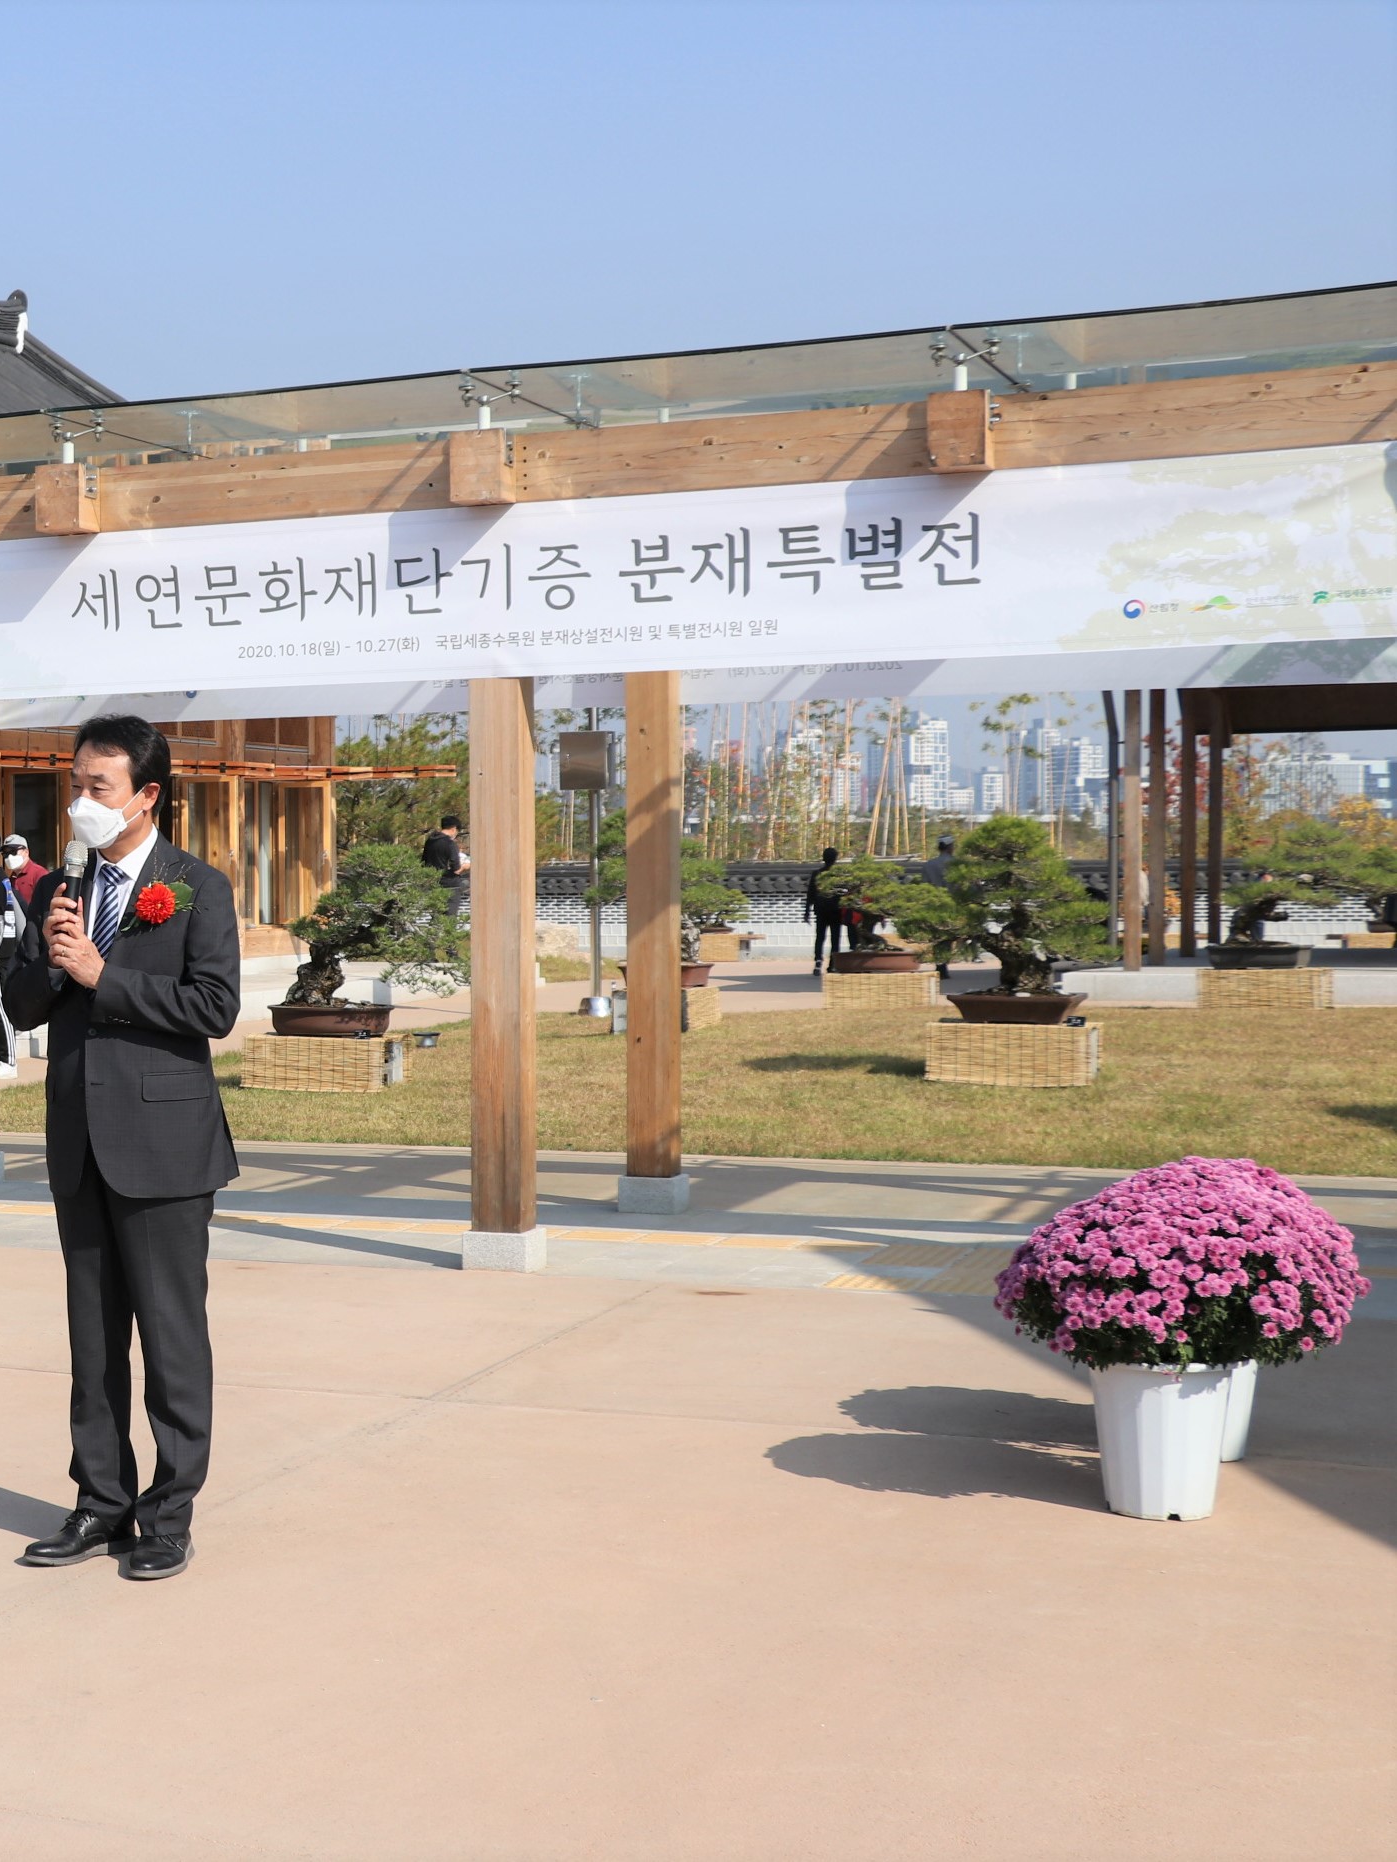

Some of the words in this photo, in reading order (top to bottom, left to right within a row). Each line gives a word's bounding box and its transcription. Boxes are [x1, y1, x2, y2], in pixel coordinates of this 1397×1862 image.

[71, 542, 592, 632] 세연문화재단기증
[618, 511, 982, 603] 분재특별전
[238, 641, 341, 658] 2020.10.18(일)
[356, 636, 421, 653] 10.27(화)
[435, 631, 535, 649] 국립세종수목원
[540, 625, 643, 645] 분재상설전시원
[648, 624, 662, 640] 및
[667, 621, 743, 639] 특별전시원
[749, 619, 778, 636] 일원
